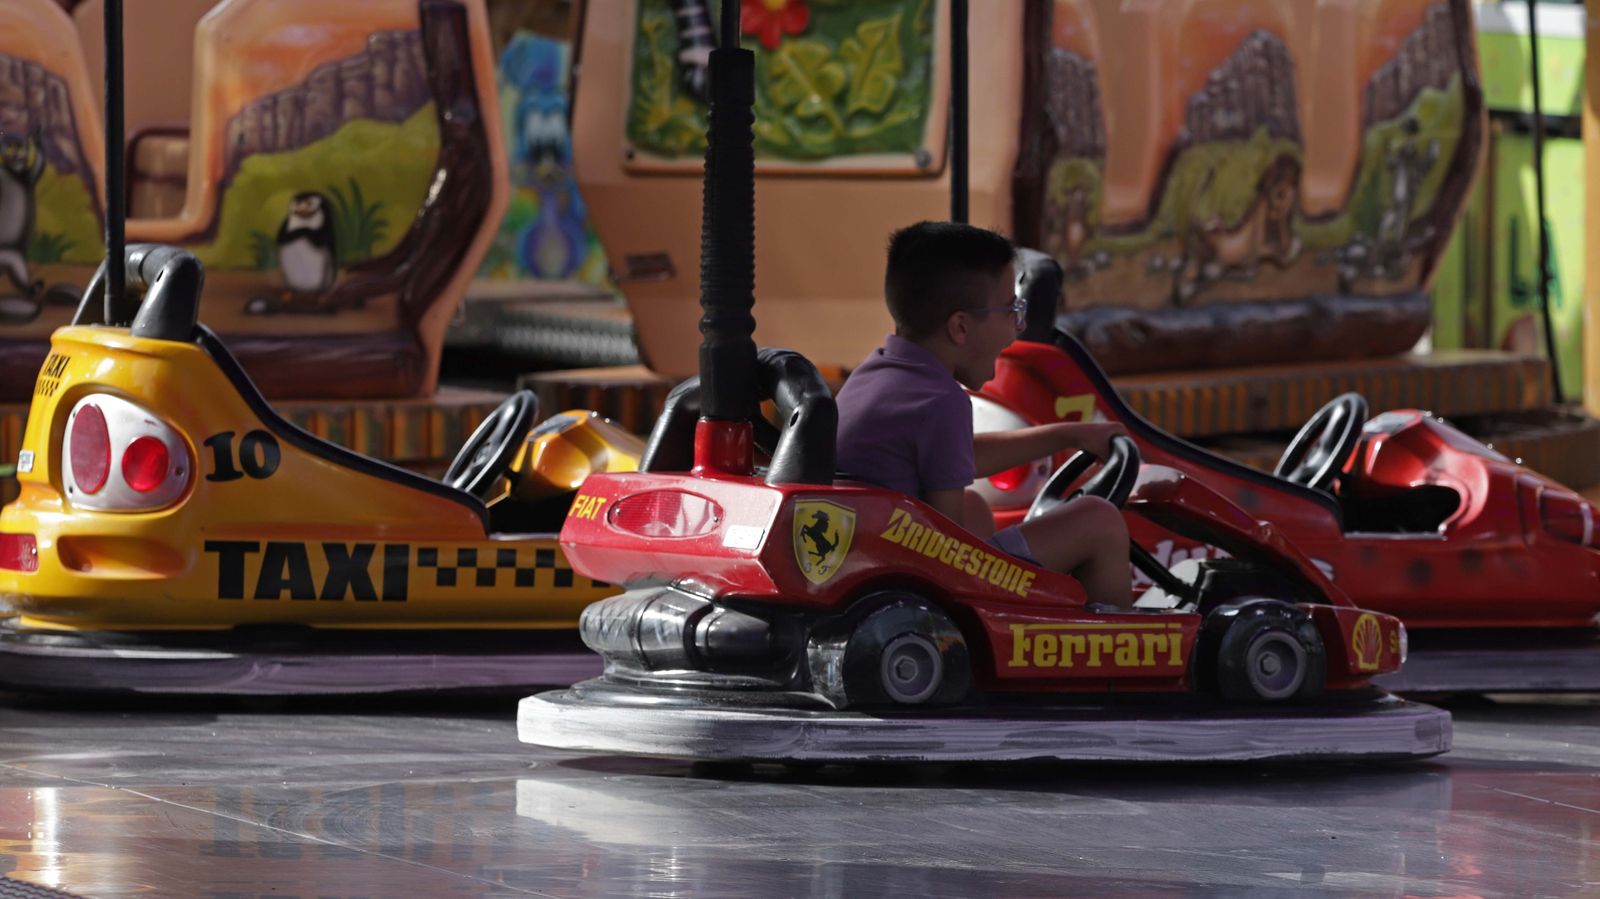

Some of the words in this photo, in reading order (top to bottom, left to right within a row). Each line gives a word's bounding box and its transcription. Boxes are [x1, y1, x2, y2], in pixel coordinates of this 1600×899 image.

[43, 354, 71, 378] TAXI
[203, 429, 281, 482] 10
[569, 495, 607, 520] FIAT
[204, 540, 410, 602] TAXI
[880, 507, 1036, 598] BRIDGESTONE
[1008, 623, 1183, 667] Ferrari
